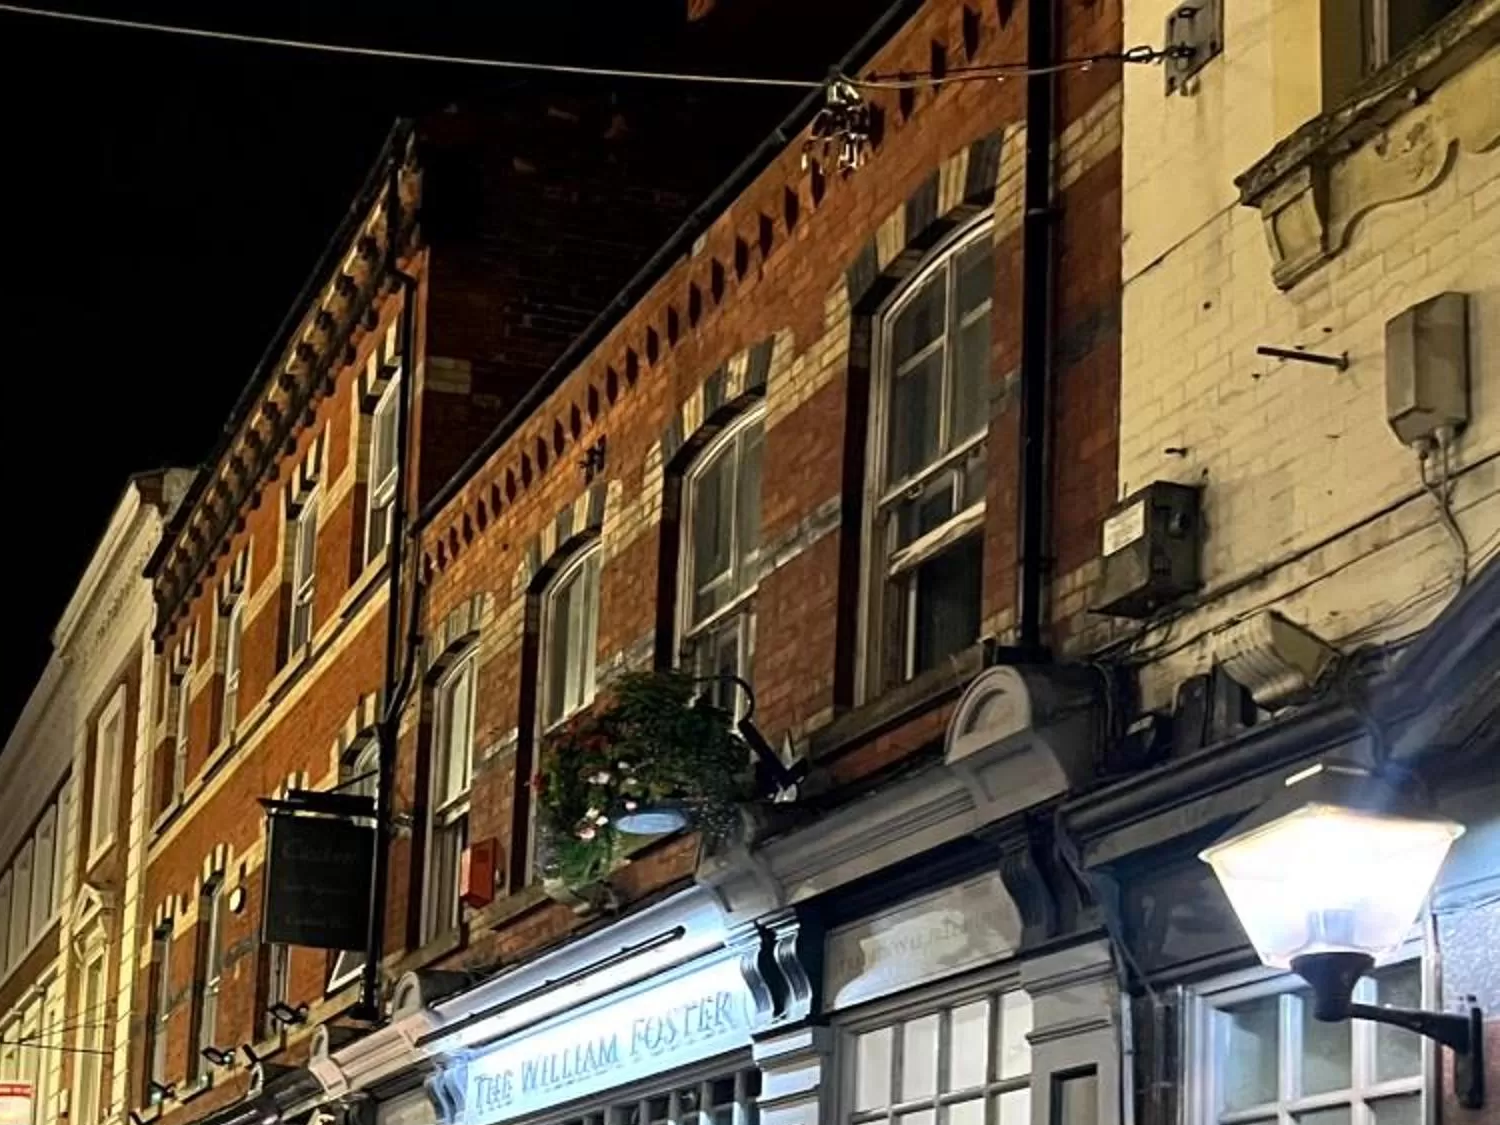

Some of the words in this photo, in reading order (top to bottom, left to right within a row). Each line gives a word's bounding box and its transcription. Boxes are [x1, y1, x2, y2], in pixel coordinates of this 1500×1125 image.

[473, 1068, 514, 1111] THE
[520, 1032, 620, 1093] WILLIAM
[629, 991, 735, 1057] FOSTER
